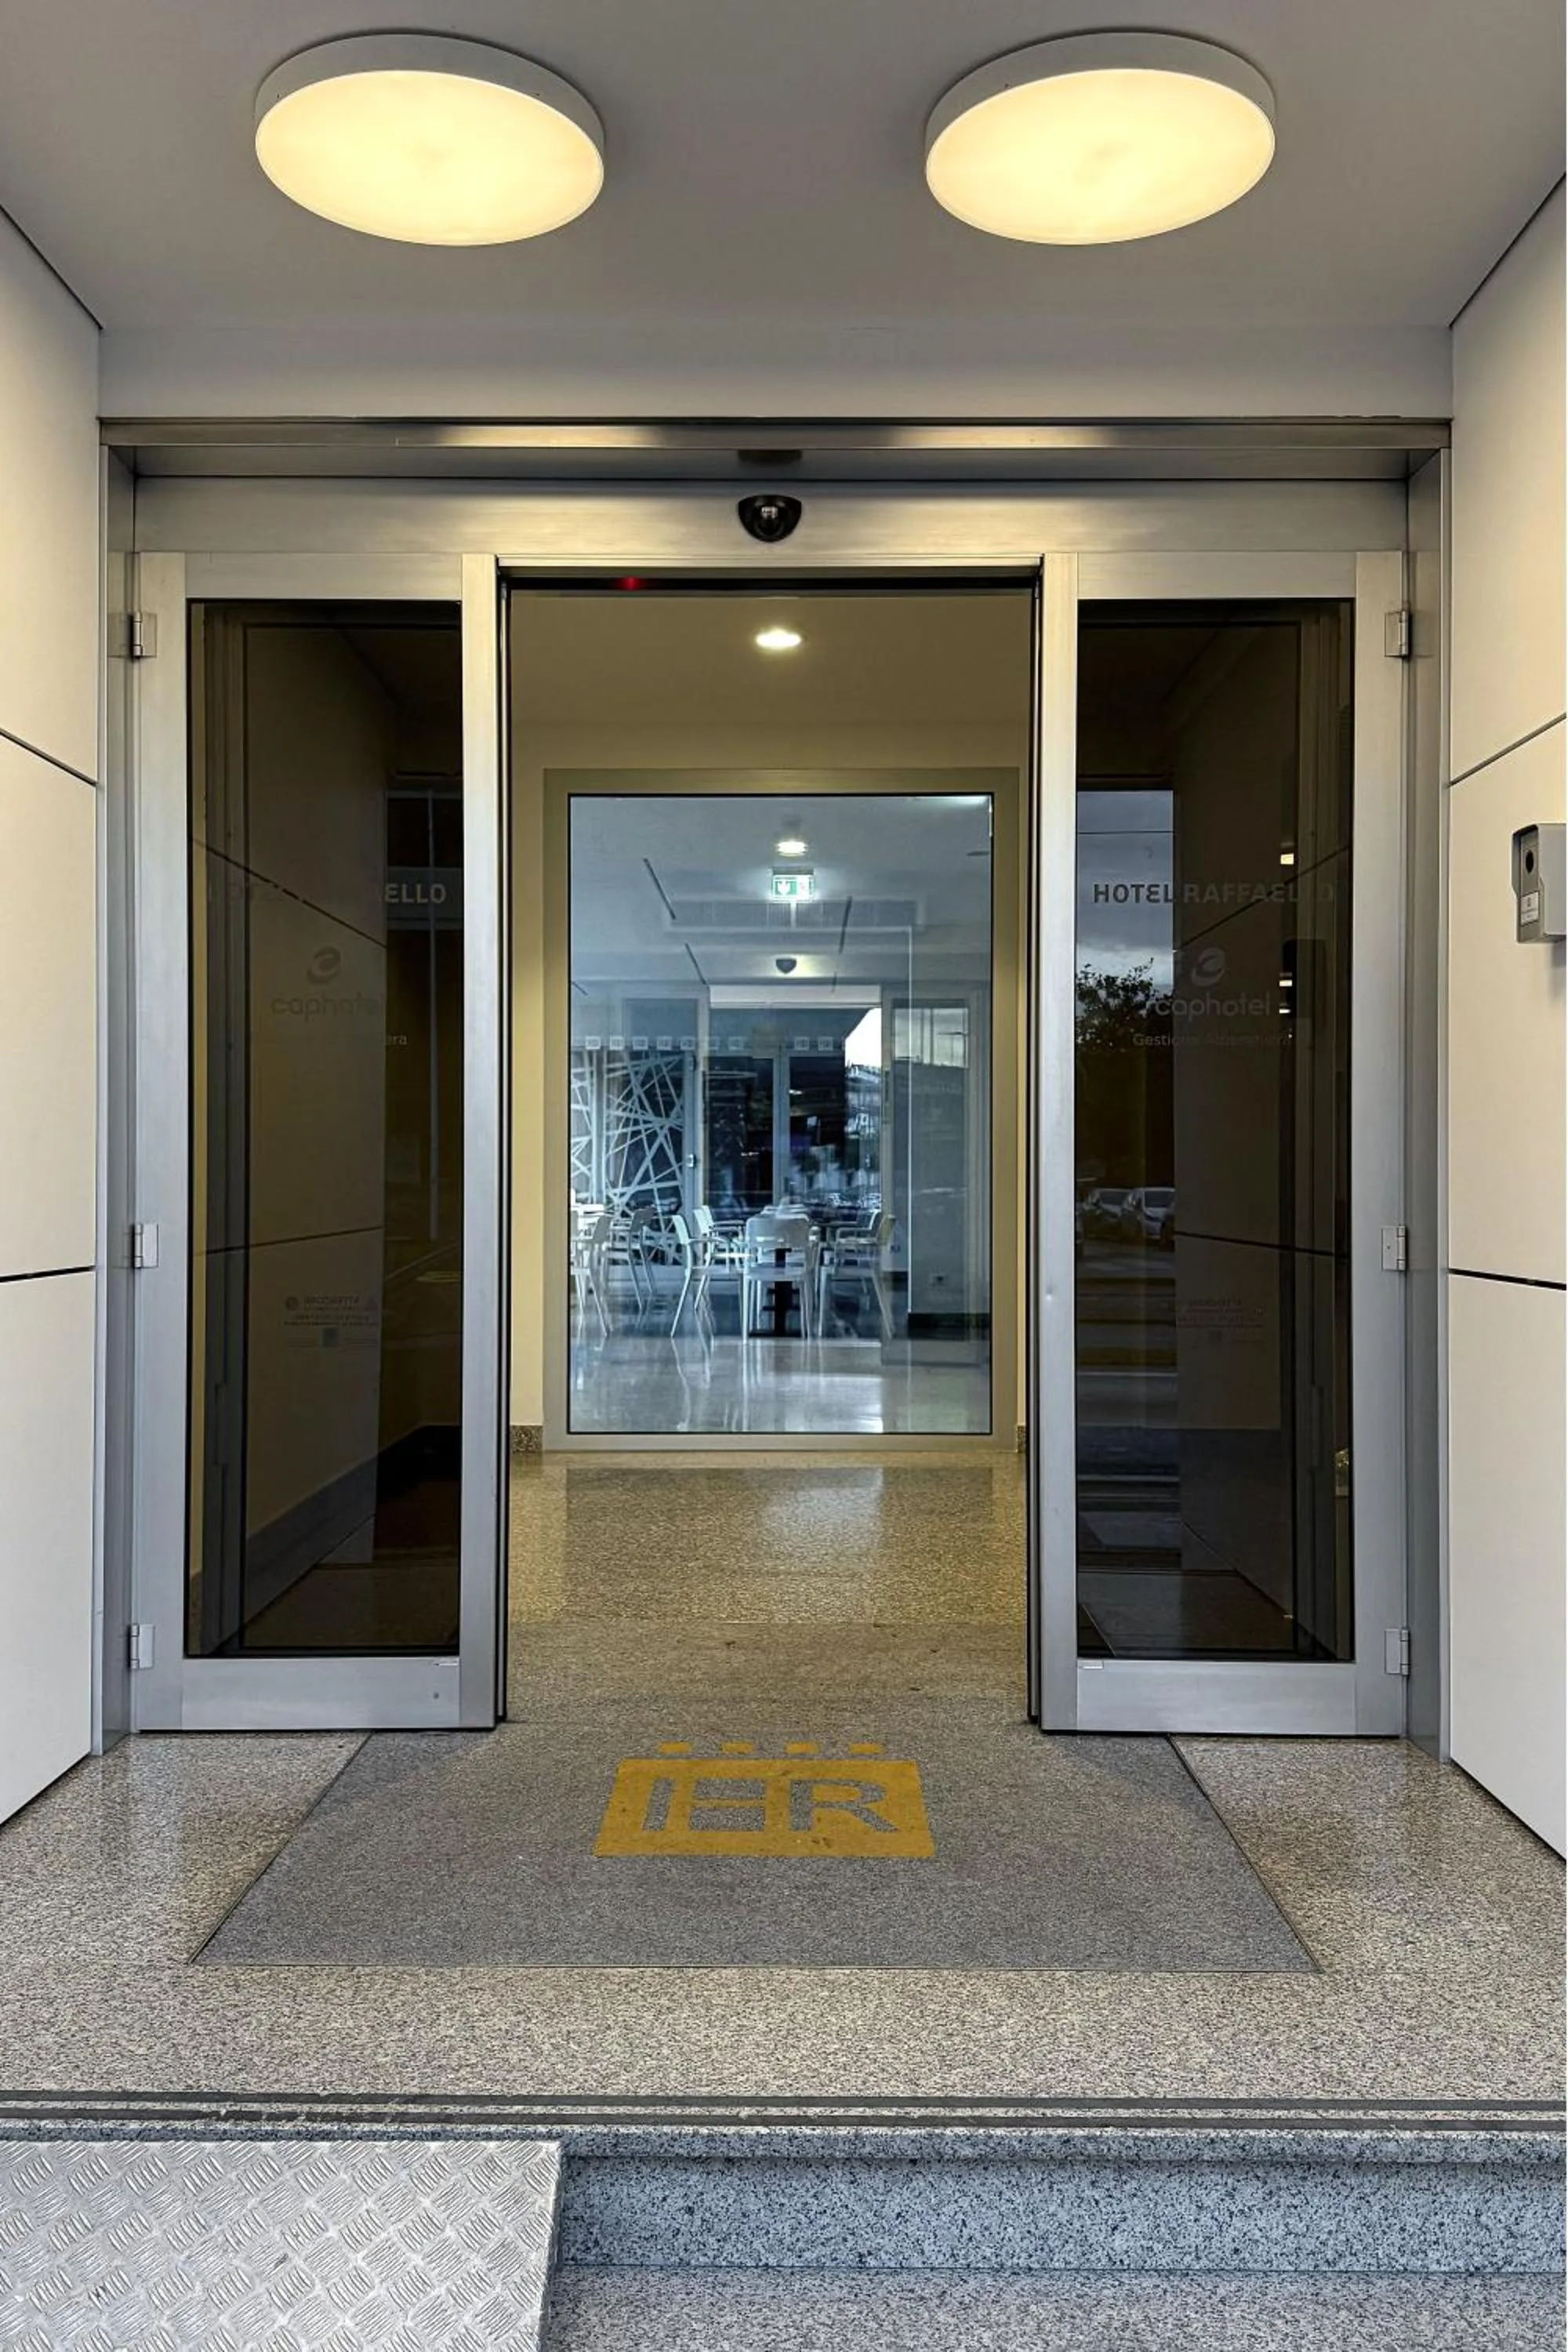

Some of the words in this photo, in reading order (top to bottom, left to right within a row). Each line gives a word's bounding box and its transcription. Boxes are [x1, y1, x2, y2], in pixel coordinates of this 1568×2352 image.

[1093, 884, 1174, 904] HOTEL
[1184, 883, 1334, 904] RAFFAELO
[1155, 992, 1270, 1021] caphotel
